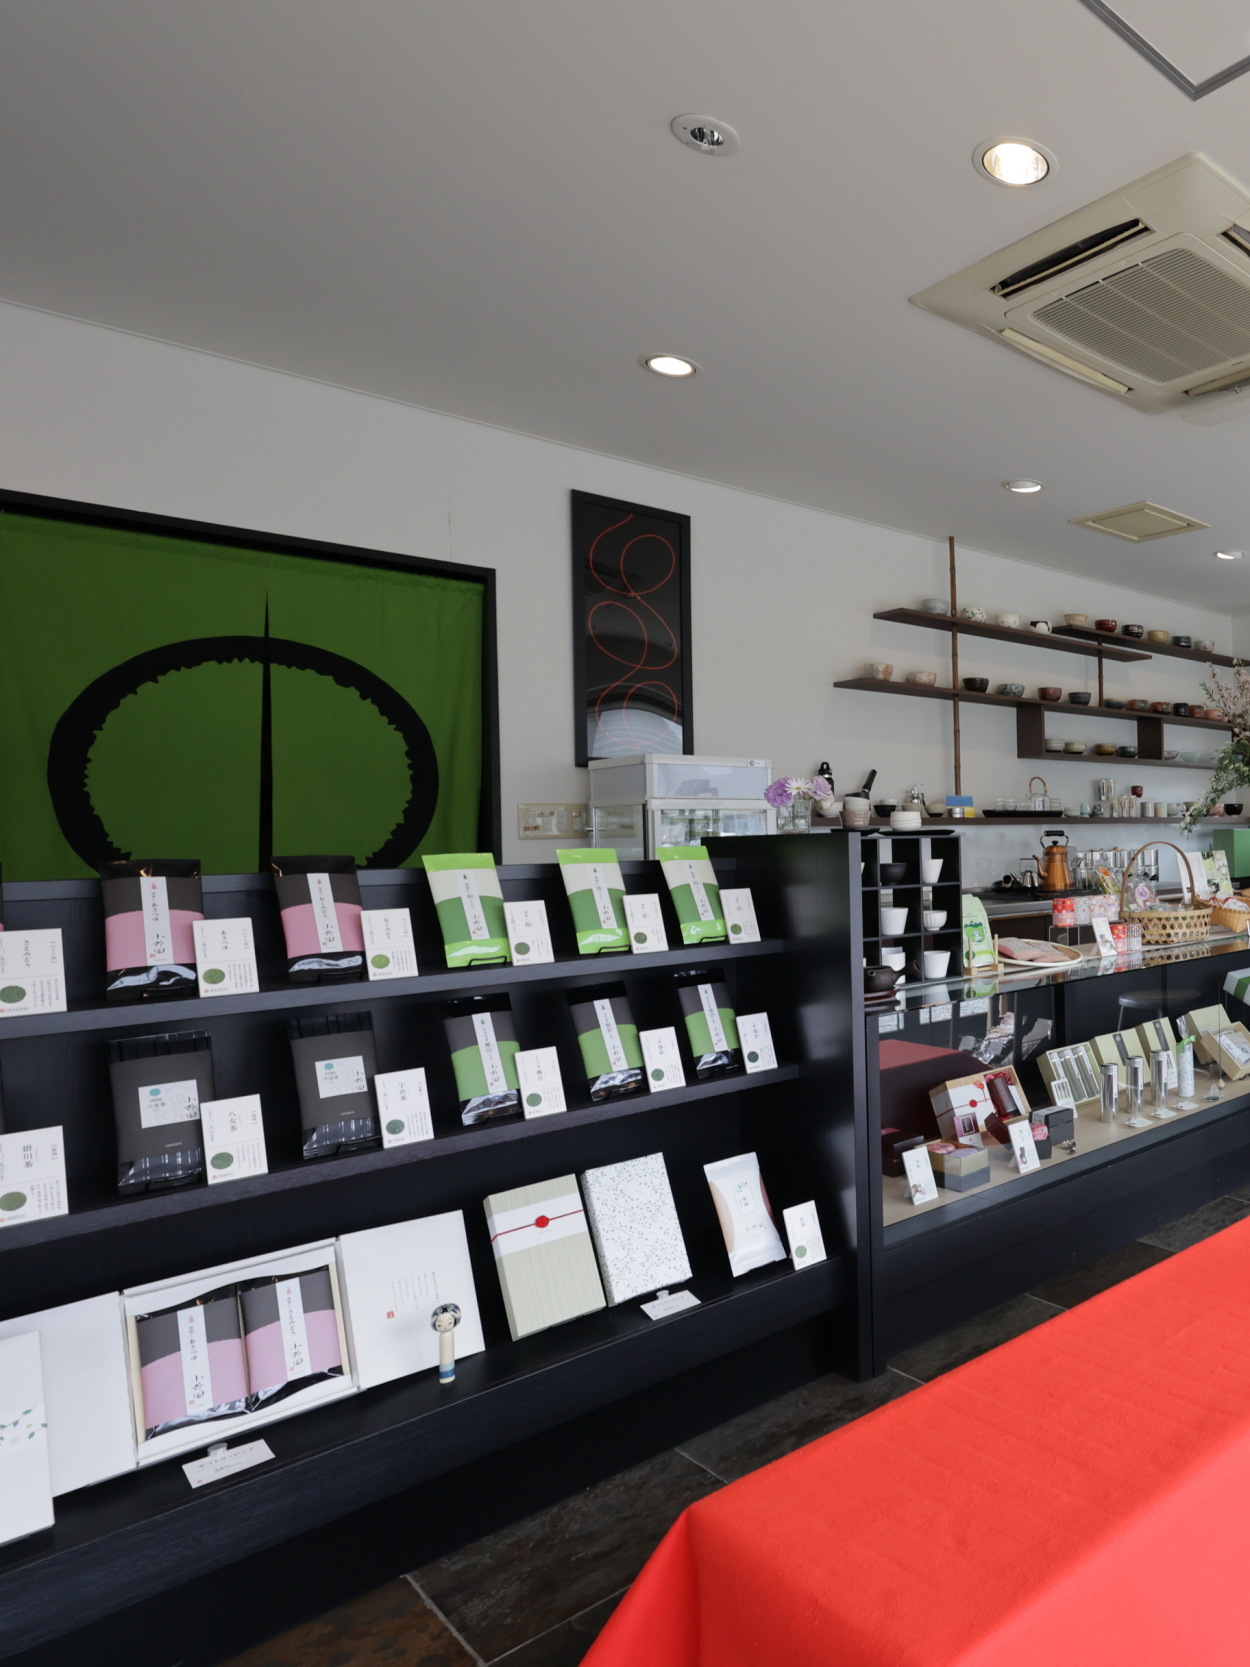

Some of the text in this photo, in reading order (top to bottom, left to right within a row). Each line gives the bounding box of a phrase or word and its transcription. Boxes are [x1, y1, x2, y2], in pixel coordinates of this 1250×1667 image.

[221, 930, 229, 950] あさつゆ
[228, 1110, 238, 1132] 八女茶
